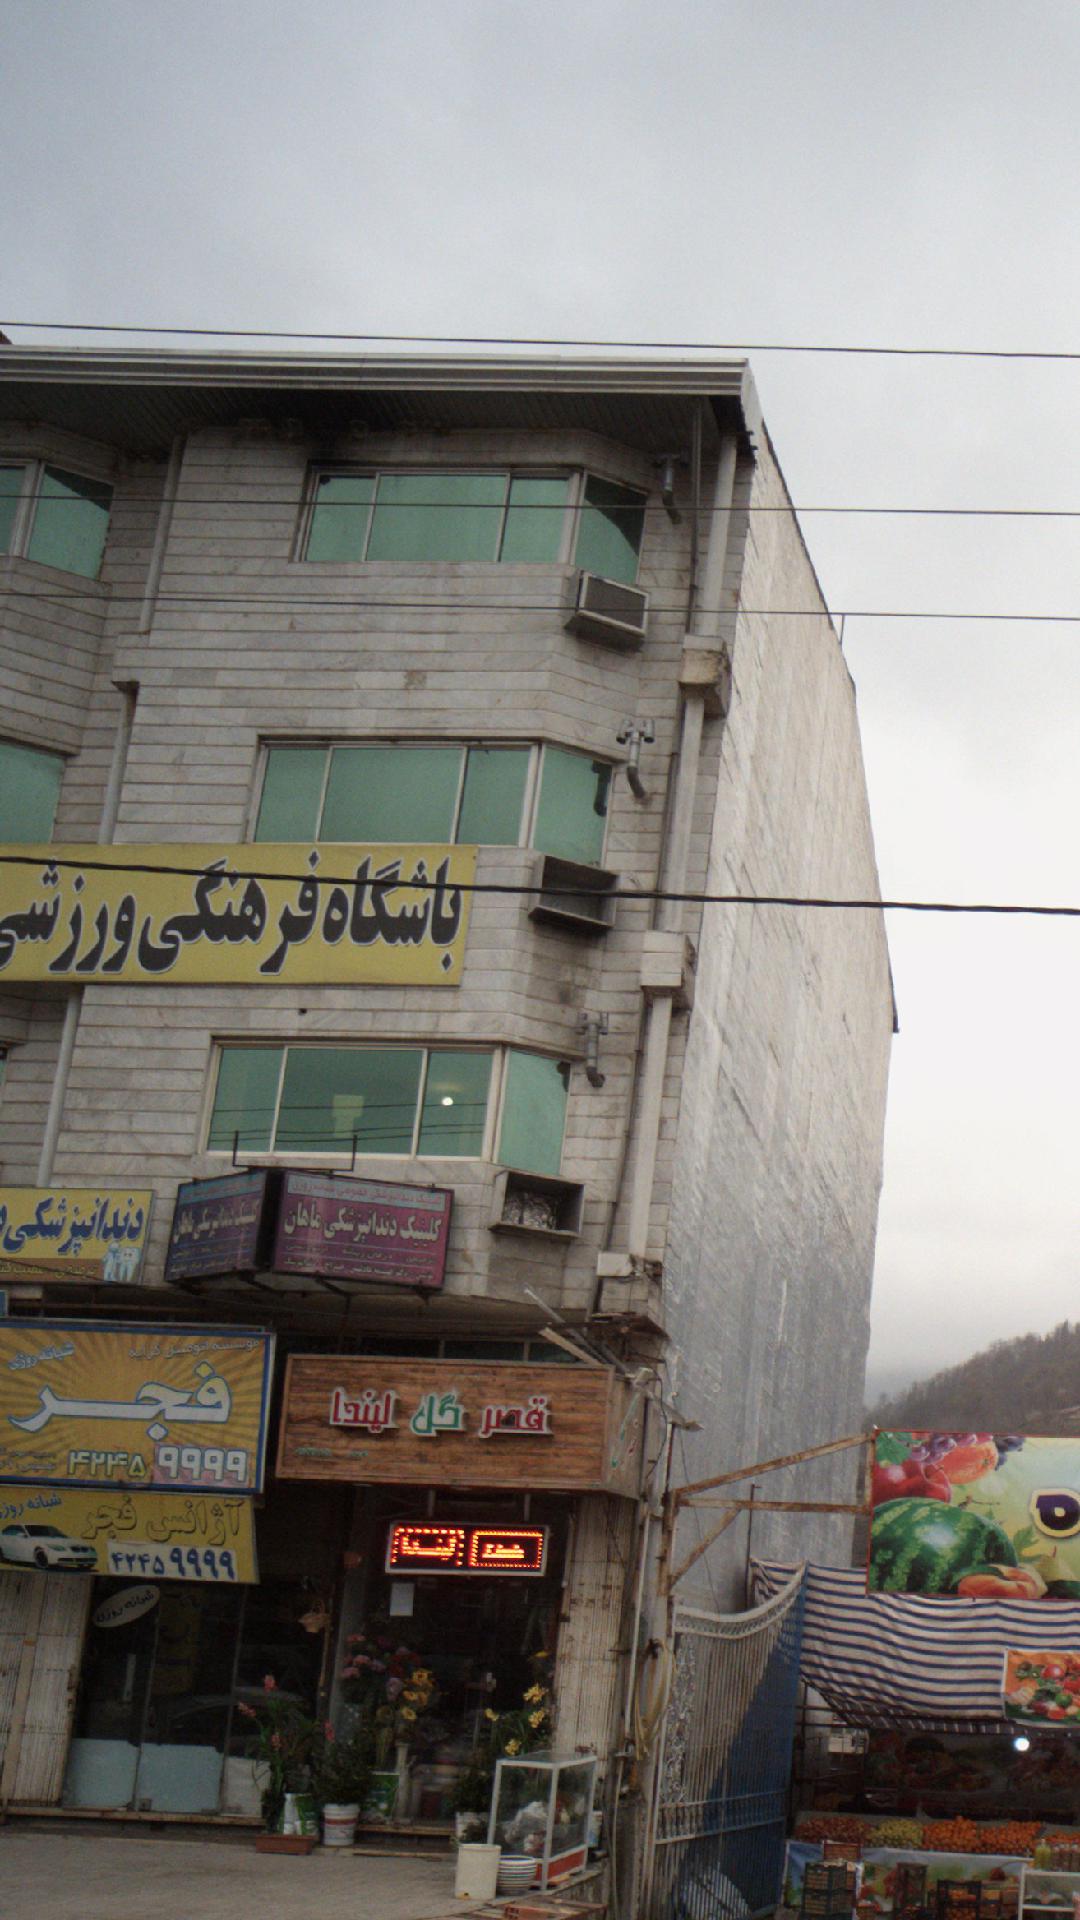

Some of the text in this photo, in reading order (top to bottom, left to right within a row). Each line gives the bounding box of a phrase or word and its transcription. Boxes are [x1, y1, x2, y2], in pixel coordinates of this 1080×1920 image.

[138, 849, 322, 974] فرهنگی
[322, 855, 462, 972] باشگاه
[2, 1196, 144, 1257] دندانپزشکی
[283, 1200, 442, 1247] کلینیک دندانپزشکی ماهان
[8, 1361, 232, 1441] فجر
[330, 1387, 550, 1438] قصر گل لیندا
[157, 1446, 248, 1482] ۹۹۹۹
[27, 1492, 62, 1511] شبانه
[81, 1495, 244, 1546] آژانس فجر
[169, 1547, 236, 1579] ۹۹۹۹
